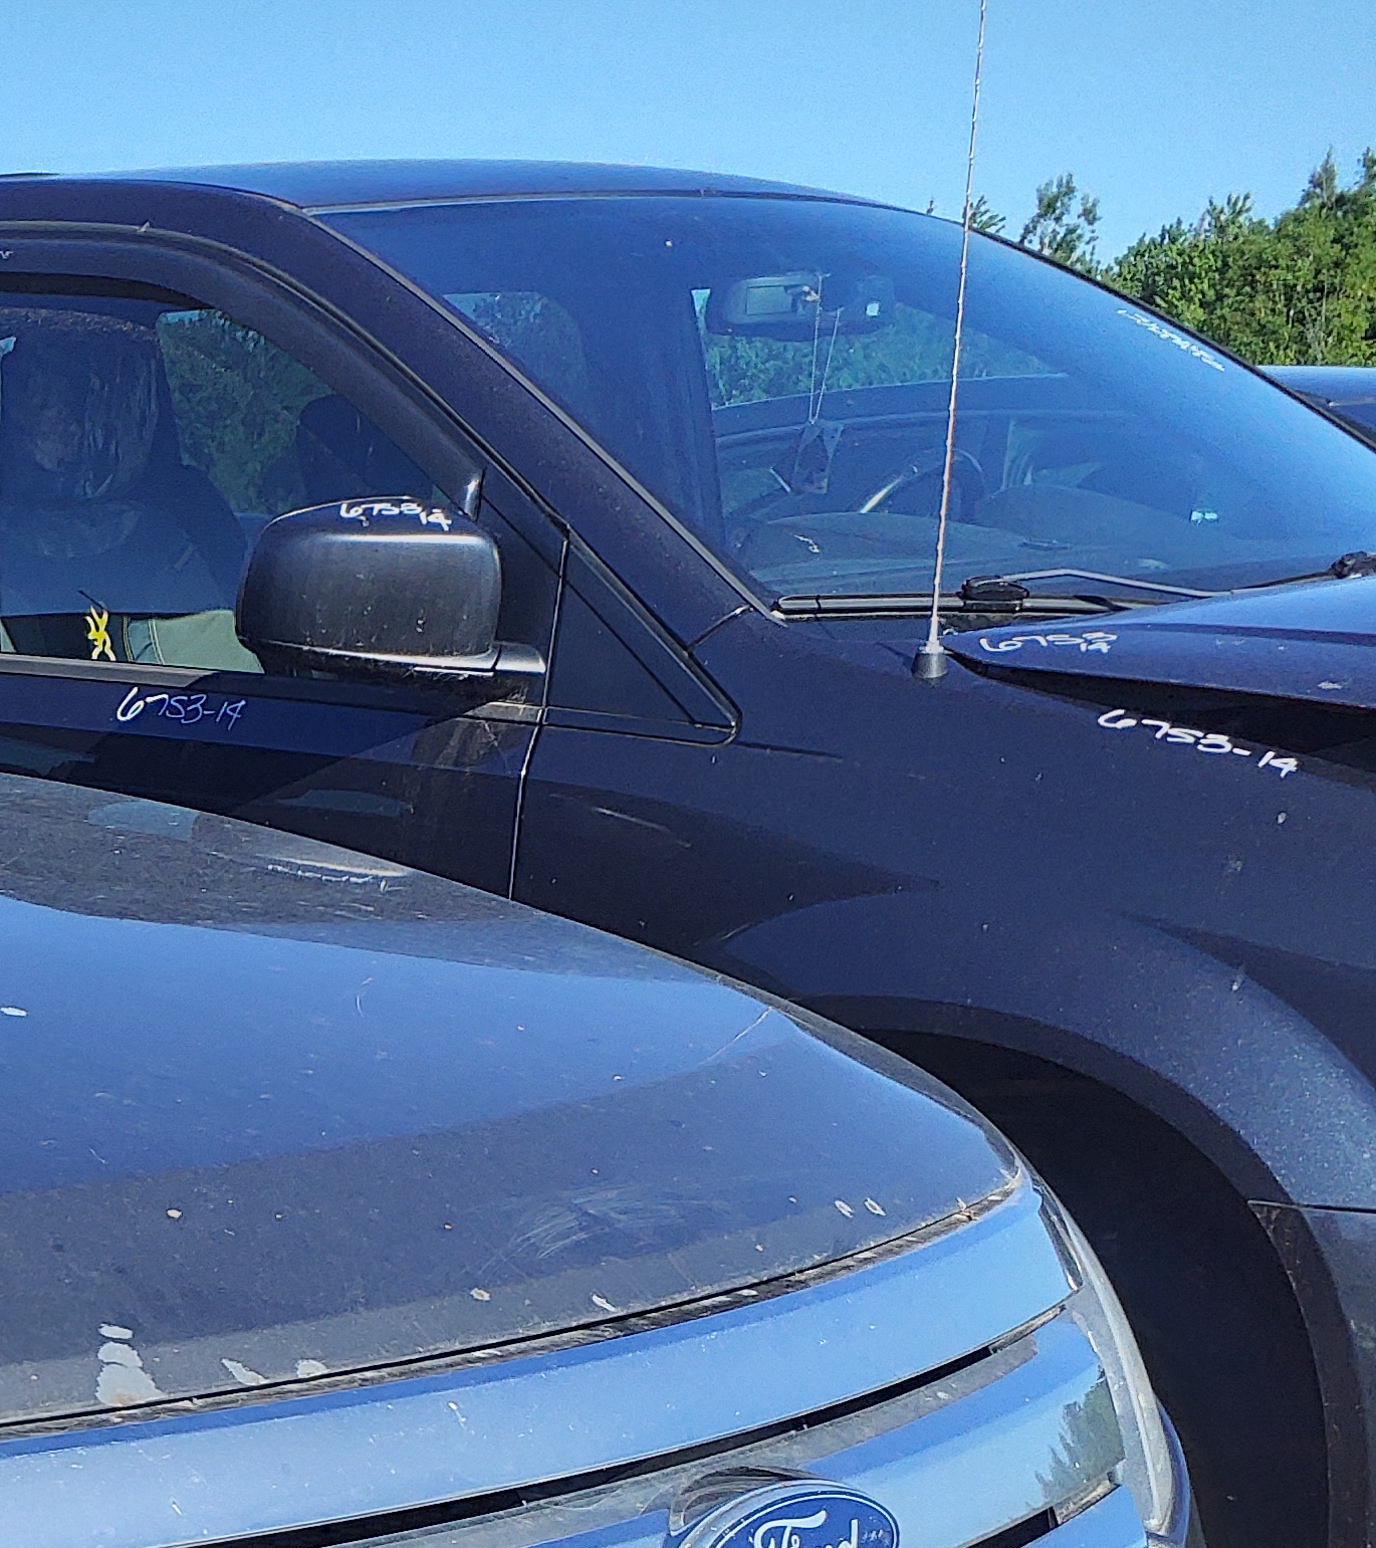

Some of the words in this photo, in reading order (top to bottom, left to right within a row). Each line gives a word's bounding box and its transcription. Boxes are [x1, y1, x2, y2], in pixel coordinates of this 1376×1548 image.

[979, 631, 1118, 652] 6753
[1079, 641, 1112, 654] 14
[115, 685, 247, 731] 6753-14
[1097, 708, 1299, 779] 6753-14
